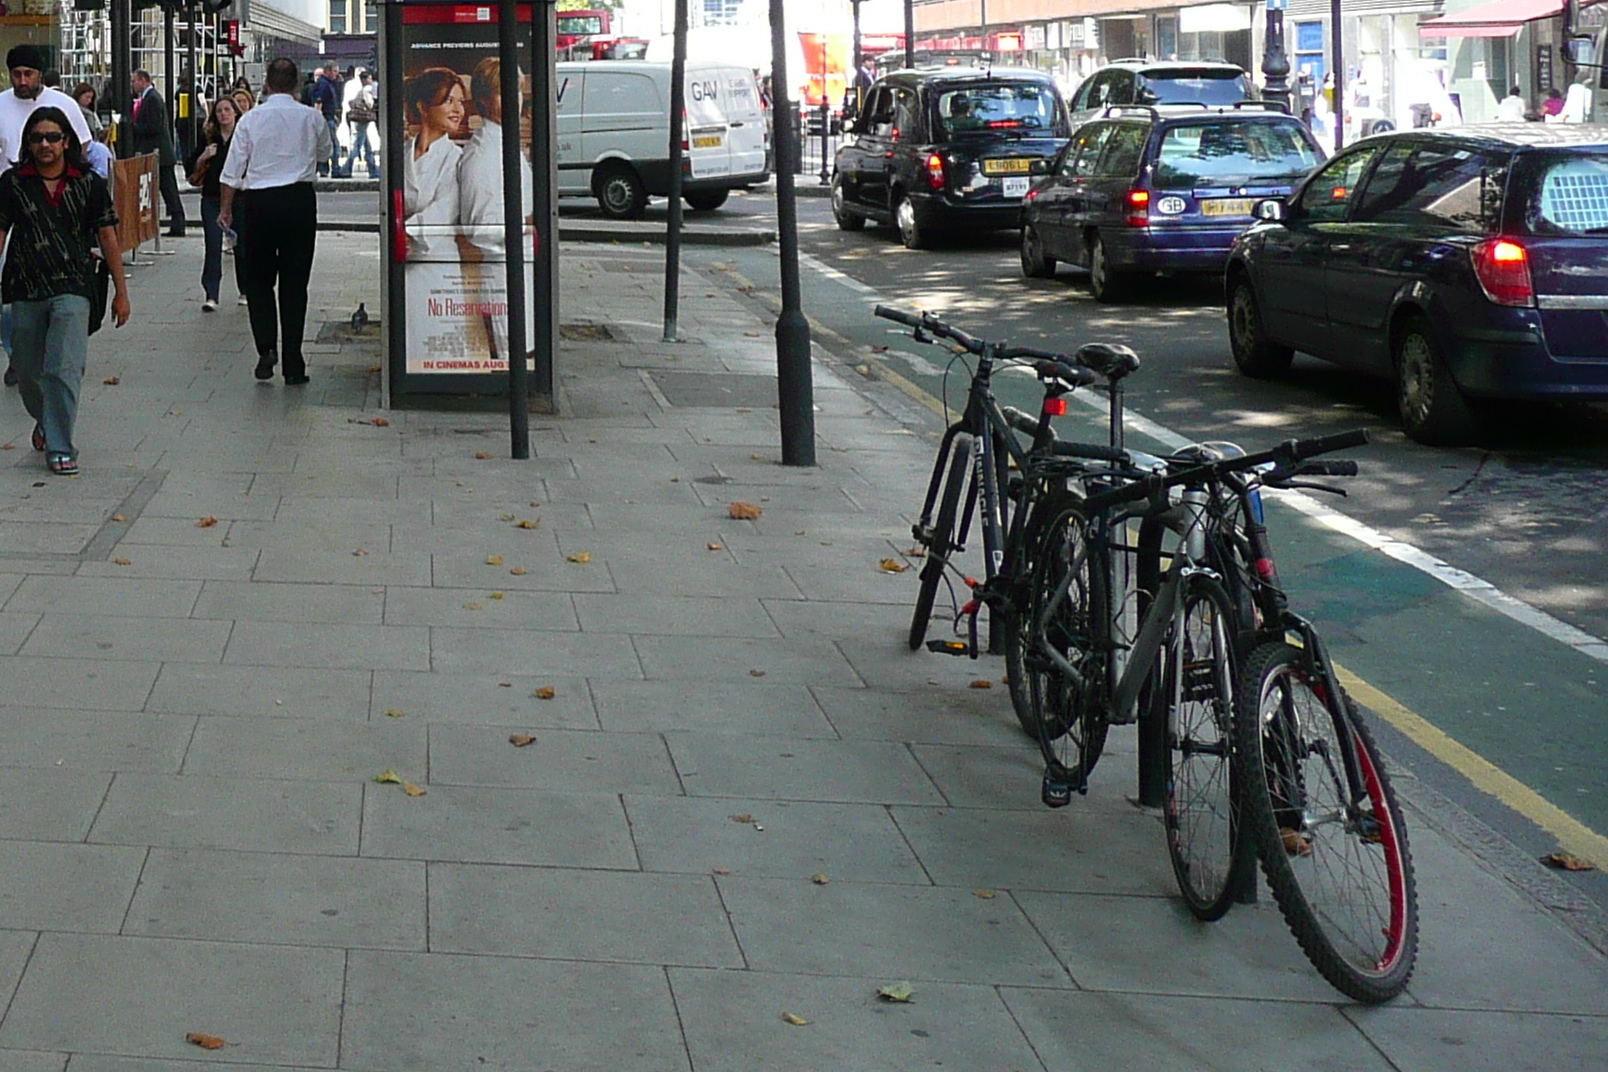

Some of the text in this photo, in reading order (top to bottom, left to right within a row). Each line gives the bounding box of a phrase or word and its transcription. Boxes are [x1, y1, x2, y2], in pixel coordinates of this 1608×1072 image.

[691, 81, 718, 101] GAV
[1162, 199, 1183, 211] GB
[428, 298, 508, 317] No Reservation
[423, 361, 505, 369] IN CINEMAS AUG
